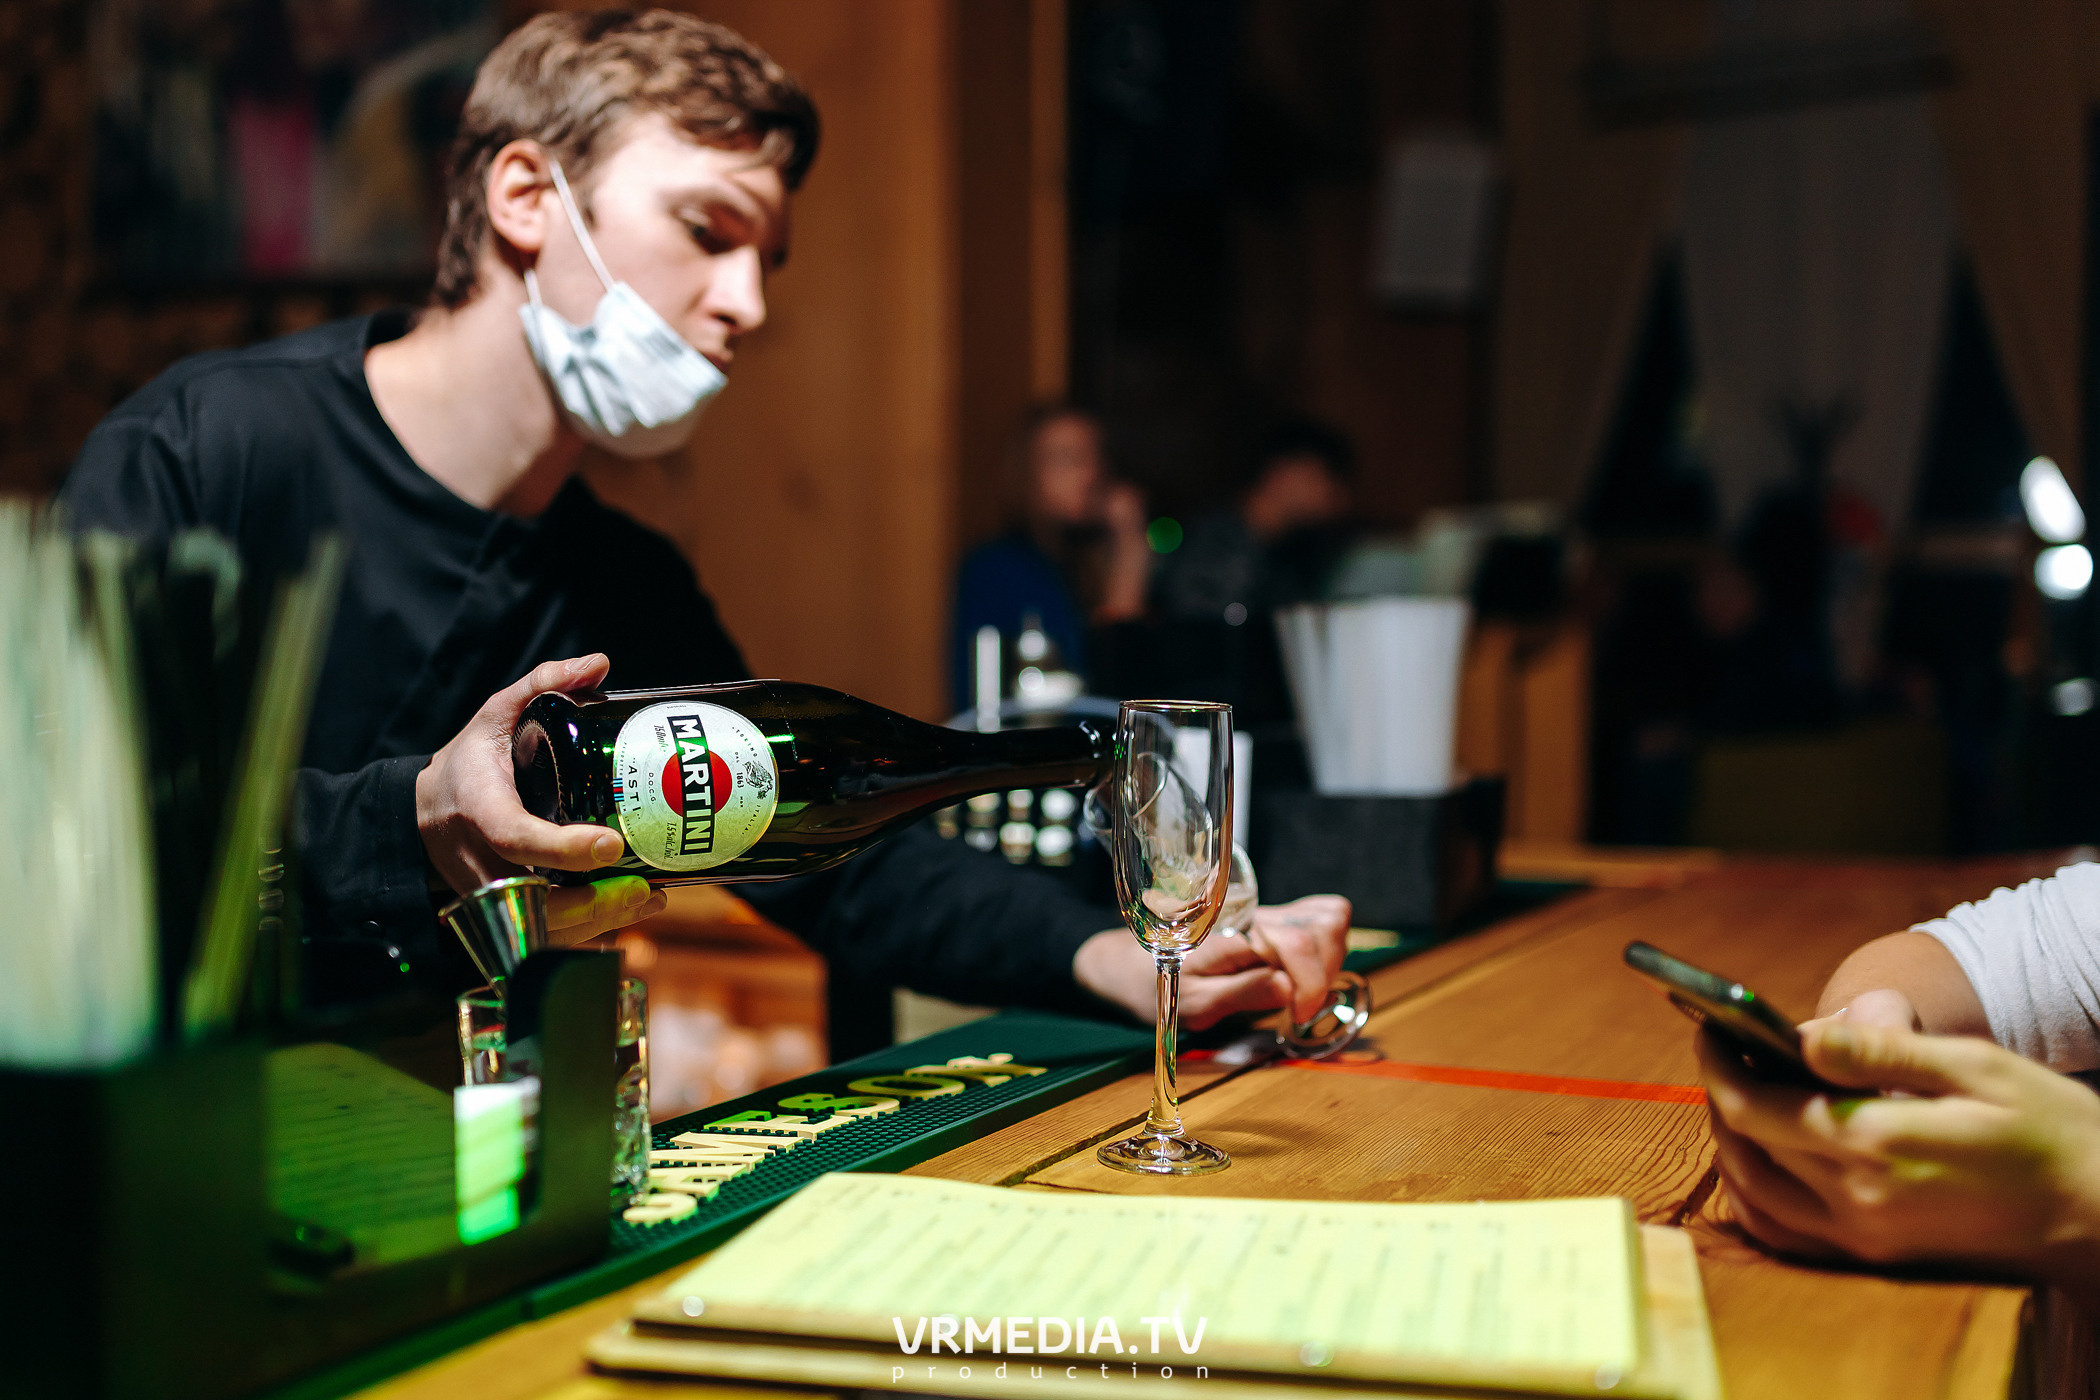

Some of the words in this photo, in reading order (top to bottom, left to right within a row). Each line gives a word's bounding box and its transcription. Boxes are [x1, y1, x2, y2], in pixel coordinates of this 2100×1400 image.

[628, 765, 641, 812] ASTI
[648, 772, 656, 805] D.O.C.G.
[671, 718, 712, 851] MARTINI
[736, 771, 745, 788] 1863
[744, 804, 761, 831] ITALIA
